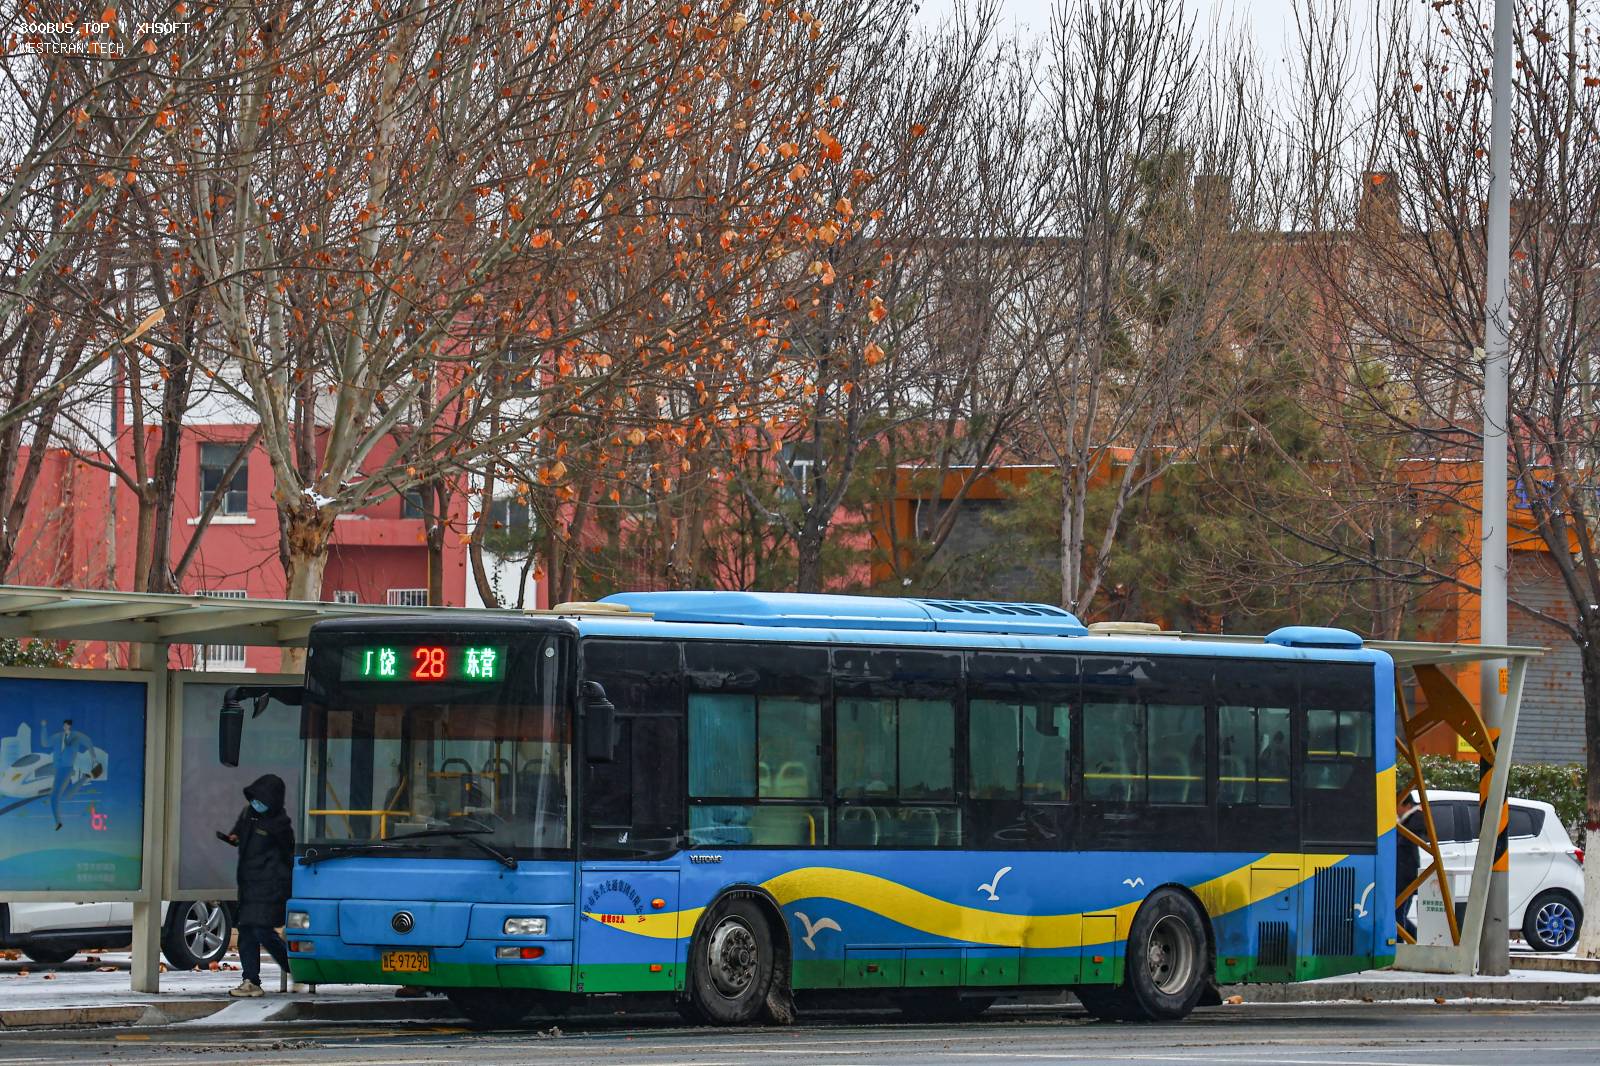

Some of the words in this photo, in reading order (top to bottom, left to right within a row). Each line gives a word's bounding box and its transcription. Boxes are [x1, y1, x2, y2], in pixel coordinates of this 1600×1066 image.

[415, 648, 445, 678] 28
[465, 647, 497, 678] 东营
[690, 854, 723, 864] YUTONG
